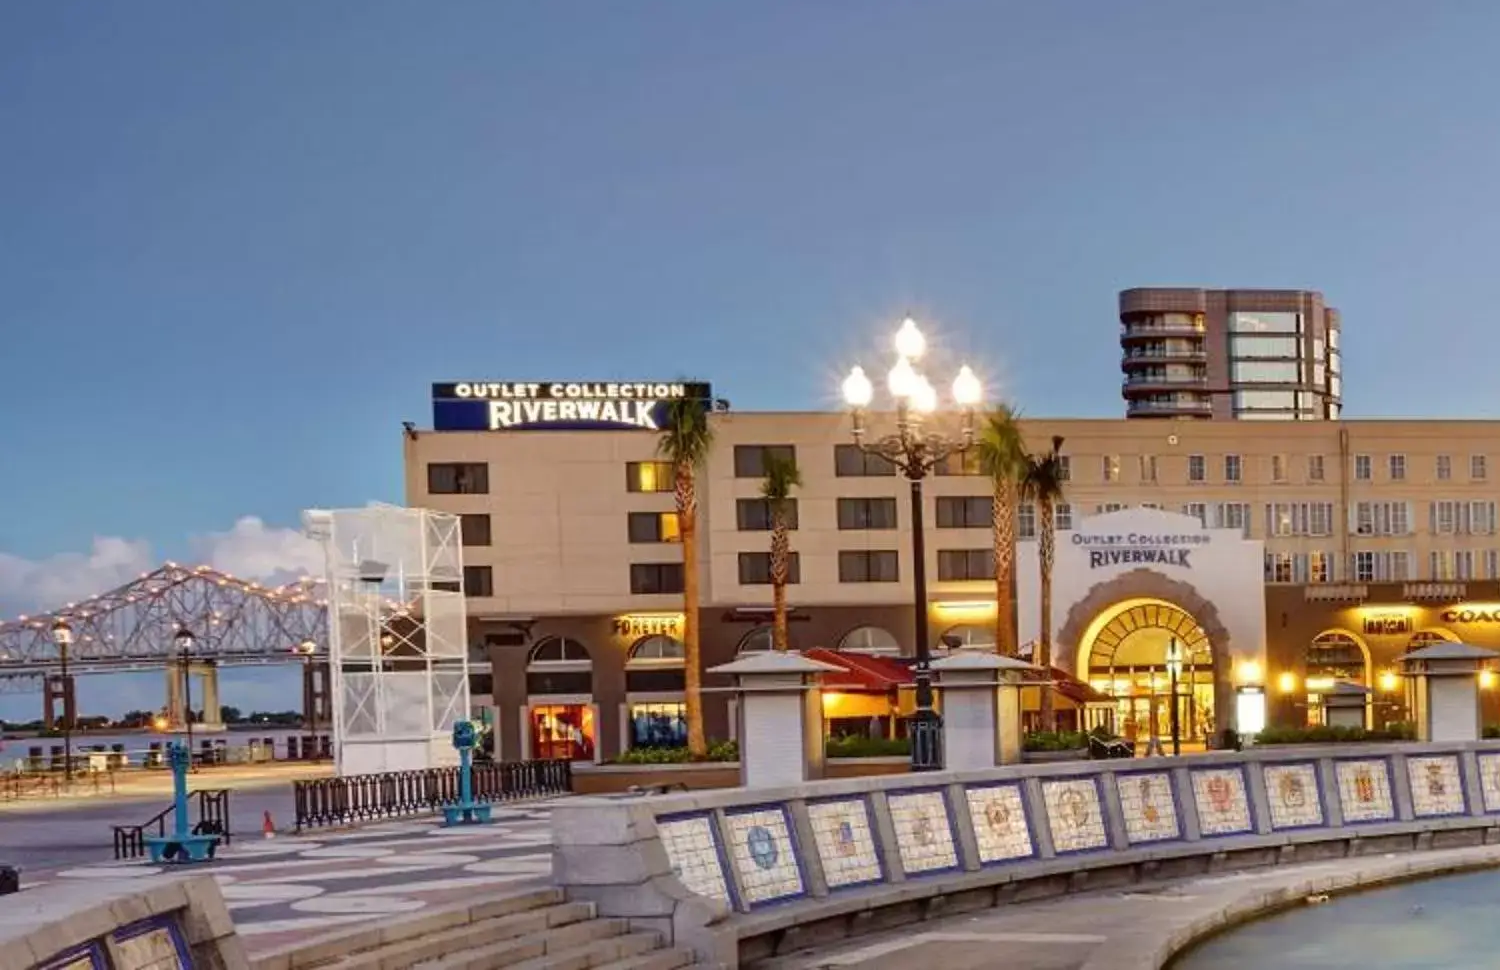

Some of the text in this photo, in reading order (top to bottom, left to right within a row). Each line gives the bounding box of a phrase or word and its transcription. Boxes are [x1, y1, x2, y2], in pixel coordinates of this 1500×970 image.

[455, 383, 685, 398] OUTLET COLLECTION
[489, 400, 659, 430] RIVERWALK
[1071, 533, 1211, 545] OUTLET COLLECTION
[1089, 549, 1192, 569] RIVERWALK
[613, 618, 678, 635] FOREVER
